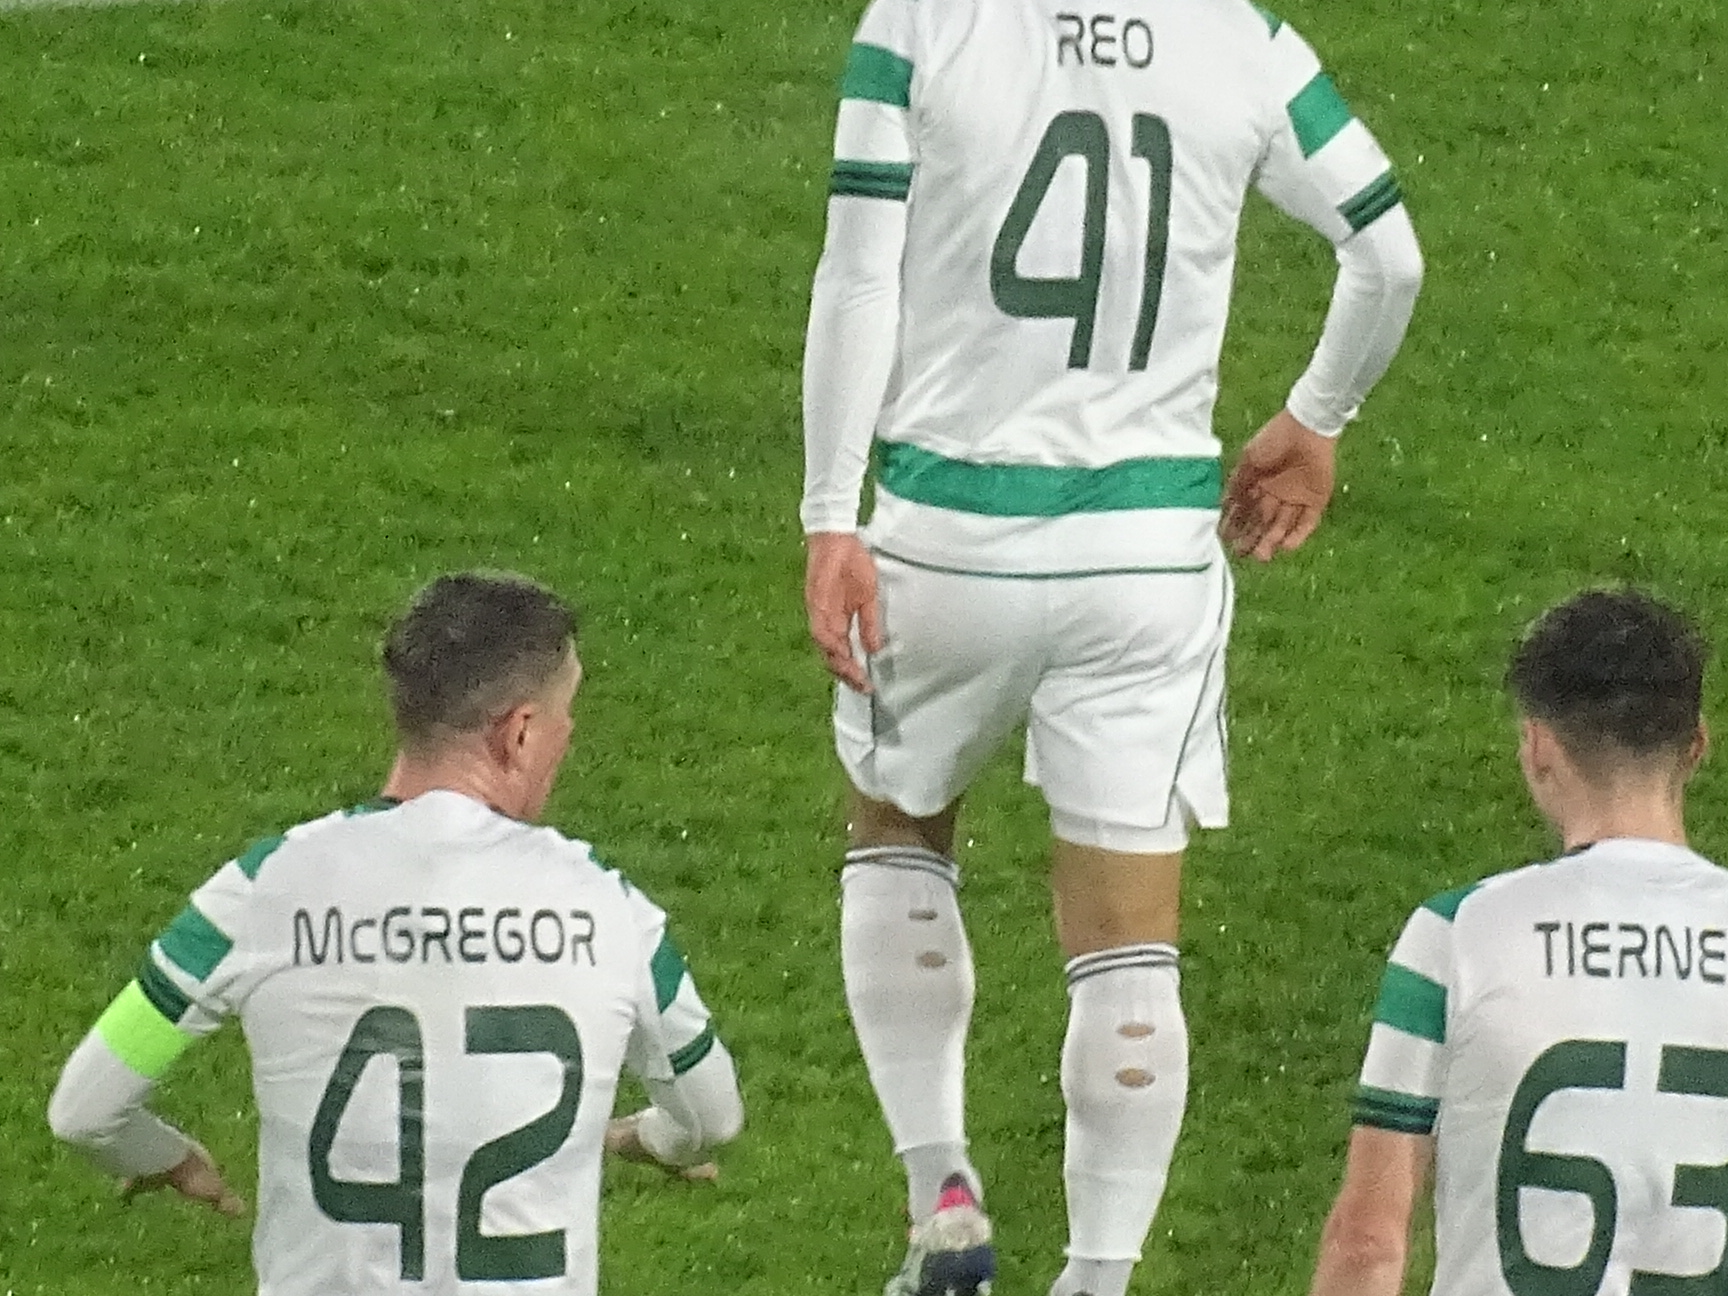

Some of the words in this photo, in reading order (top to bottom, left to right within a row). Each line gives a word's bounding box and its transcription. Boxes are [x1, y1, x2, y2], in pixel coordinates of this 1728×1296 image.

[1054, 11, 1155, 69] REO
[990, 110, 1173, 372] 41
[293, 906, 596, 968] McGREGOR
[307, 1005, 585, 1282] 42
